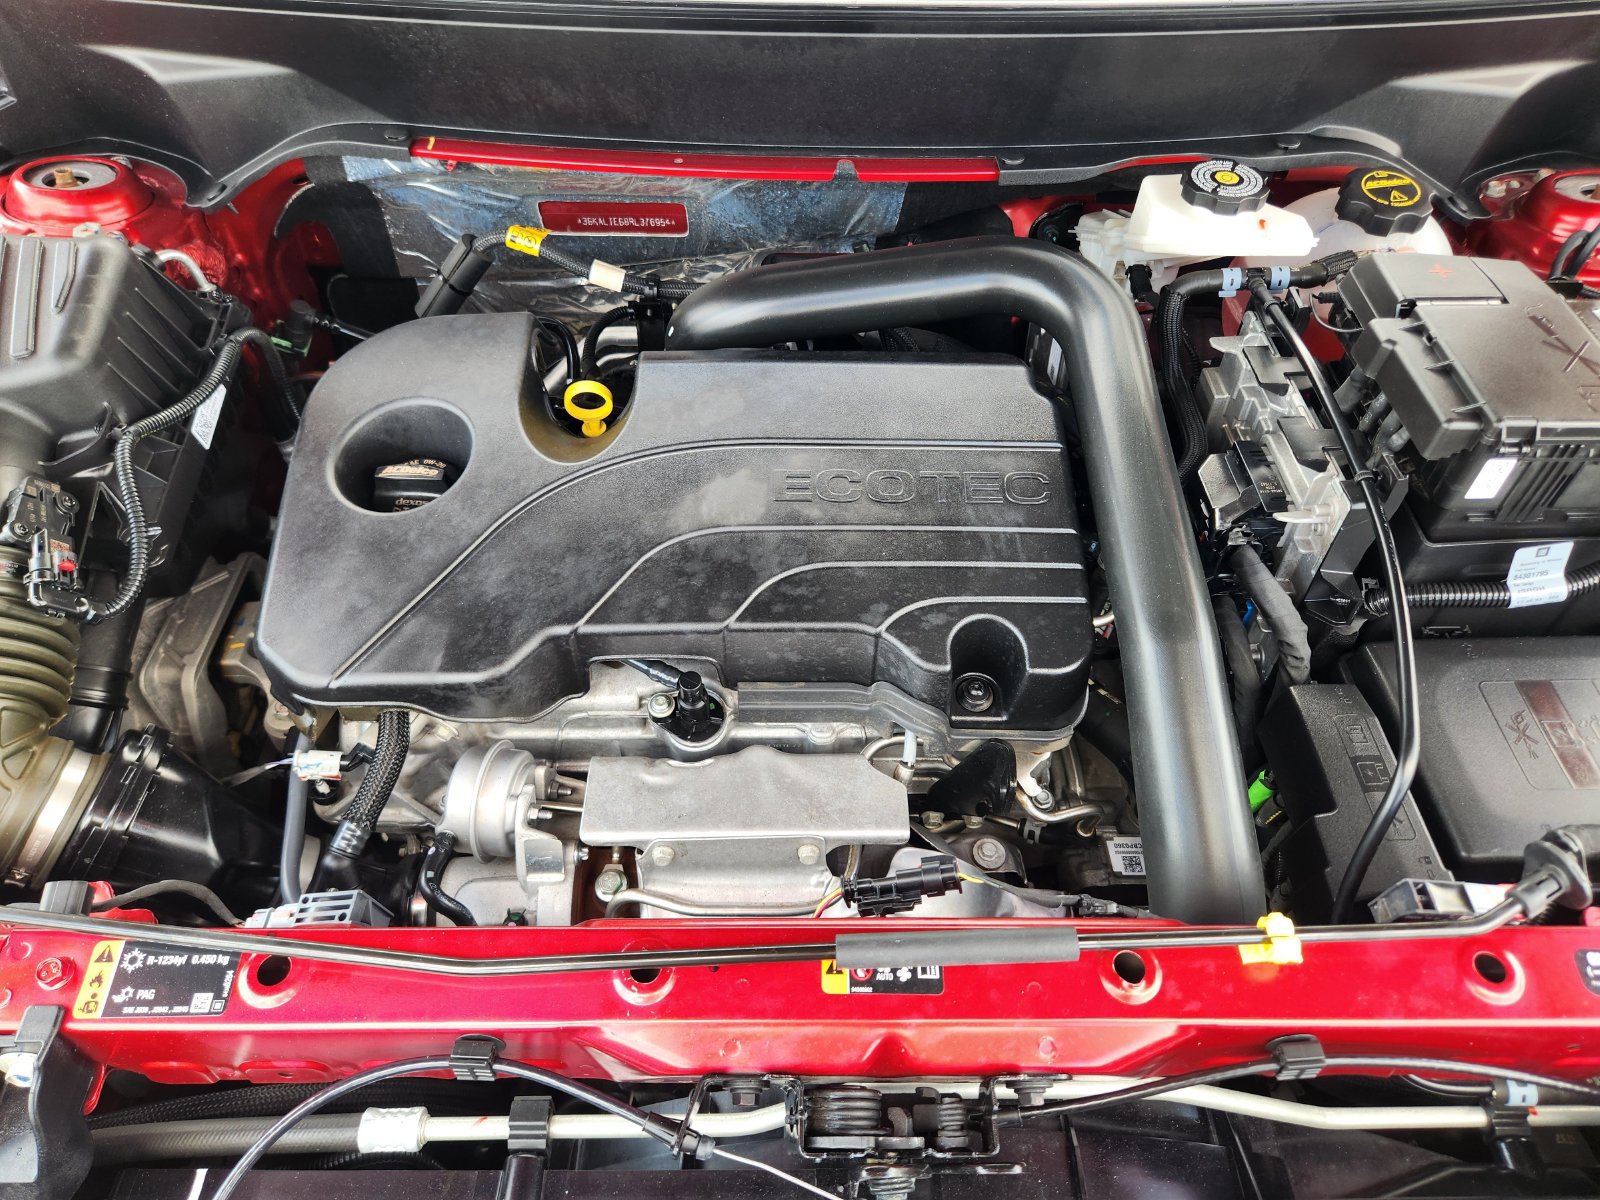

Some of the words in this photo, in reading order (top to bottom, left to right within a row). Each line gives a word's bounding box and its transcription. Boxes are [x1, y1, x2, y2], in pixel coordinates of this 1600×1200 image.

[771, 468, 1051, 504] ECOTEC
[146, 954, 189, 967] R-1234yf
[190, 954, 216, 965] 0.450
[217, 954, 231, 966] kg
[875, 972, 894, 981] AUTO
[135, 988, 156, 1000] PAG
